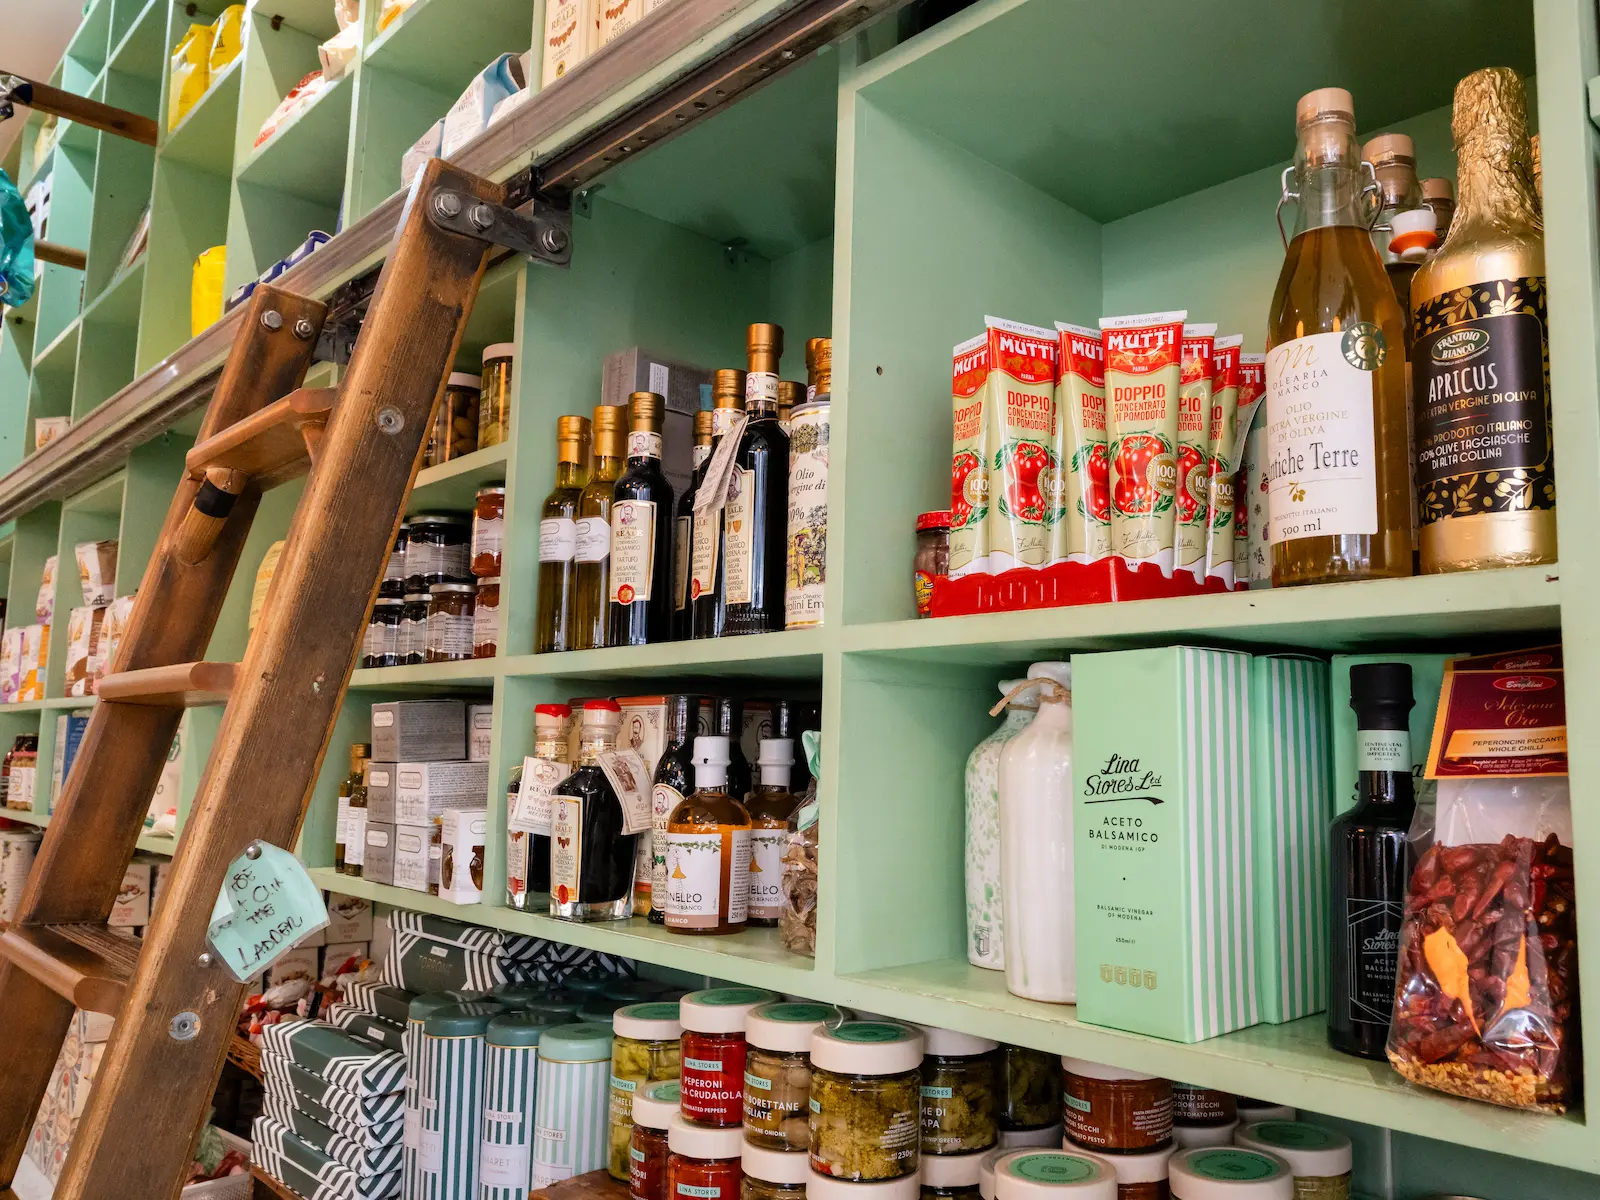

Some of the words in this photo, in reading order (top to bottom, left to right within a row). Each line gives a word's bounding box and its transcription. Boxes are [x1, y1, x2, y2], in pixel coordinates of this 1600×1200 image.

[1108, 329, 1174, 350] MUTTI
[1437, 331, 1480, 350] FRANTOIO
[1000, 336, 1054, 361] MUTTI
[1071, 339, 1103, 361] MUT
[1181, 343, 1208, 359] TTI
[1442, 343, 1475, 359] BIANCO
[954, 350, 987, 377] MUTT
[1214, 354, 1231, 370] TI
[1239, 369, 1260, 384] TI
[1273, 369, 1328, 390] OLEARIA
[1428, 363, 1499, 403] APRICUS
[1114, 384, 1166, 402] DOPPIO
[1277, 380, 1320, 398] MANCO
[1007, 390, 1051, 412] DOPPIO
[1114, 399, 1166, 412] CONCENTRATO
[1179, 397, 1201, 413] PIO
[1285, 401, 1312, 415] OLIO
[1449, 395, 1489, 412] VERGINE
[1492, 393, 1503, 403] DI
[1505, 390, 1537, 402] OLIVA
[954, 401, 982, 424] DOPPIO
[1007, 406, 1050, 424] CONCENTRATO
[1114, 412, 1121, 423] DI
[1123, 409, 1166, 421] POMODORO
[1178, 413, 1201, 423] TRATO
[1293, 410, 1348, 427] VERGINE
[1017, 418, 1050, 433] POMODORO
[1178, 421, 1202, 432] ODORO
[1433, 424, 1484, 444] PRODOTTO
[1486, 419, 1533, 432] ITALIANO
[1278, 433, 1288, 443] DI
[1289, 426, 1326, 440] OLIVA
[1435, 442, 1459, 457] OLIVE
[1461, 432, 1530, 451] TAGGIASCHE
[1309, 442, 1359, 471] Terre
[1431, 458, 1440, 470] DI
[1440, 453, 1458, 467] ALTA
[1459, 447, 1502, 464] COLLINA
[795, 468, 815, 481] Olio
[815, 480, 826, 491] di
[970, 479, 989, 491] 100
[1301, 506, 1338, 517] ITALIANO
[616, 529, 644, 537] REALE
[1282, 524, 1299, 539] 500
[1303, 518, 1322, 533] ml
[1505, 710, 1539, 727] Oro
[1527, 736, 1564, 744] PICCANTI
[1100, 753, 1141, 775] Lina
[529, 786, 552, 795] REAL
[1084, 774, 1134, 797] Stores
[1135, 770, 1162, 792] Ltd
[1103, 816, 1143, 828] ACETO
[1089, 829, 1159, 843] BALSAMICO
[1108, 844, 1134, 852] MODENA
[246, 903, 275, 924] THE
[1096, 904, 1126, 914] BALSAMIC
[1127, 907, 1154, 916] VINEGAR
[1114, 913, 1142, 922] MODENA
[243, 916, 303, 970] LADDER
[1363, 938, 1396, 950] Stores
[1365, 965, 1396, 973] BALSAM
[698, 1061, 719, 1069] STORES
[616, 1080, 634, 1090] STORES
[684, 1076, 722, 1089] PEPERONI
[751, 1078, 769, 1088] STORES
[689, 1088, 742, 1100] CRUDAIOLA
[924, 1088, 949, 1096] STORES
[1173, 1093, 1196, 1101] PESTO
[748, 1094, 799, 1111] BORETTANE
[1071, 1100, 1088, 1110] STORES
[1196, 1101, 1220, 1109] SECCHI
[497, 1113, 519, 1121] STORES
[704, 1106, 727, 1114] PEPPERS
[935, 1107, 946, 1117] DI
[921, 1119, 940, 1129] APA
[1077, 1122, 1100, 1134] SECCHI
[544, 1131, 563, 1139] STORES
[764, 1129, 786, 1138] ONIONS
[1087, 1136, 1106, 1144] PESTO
